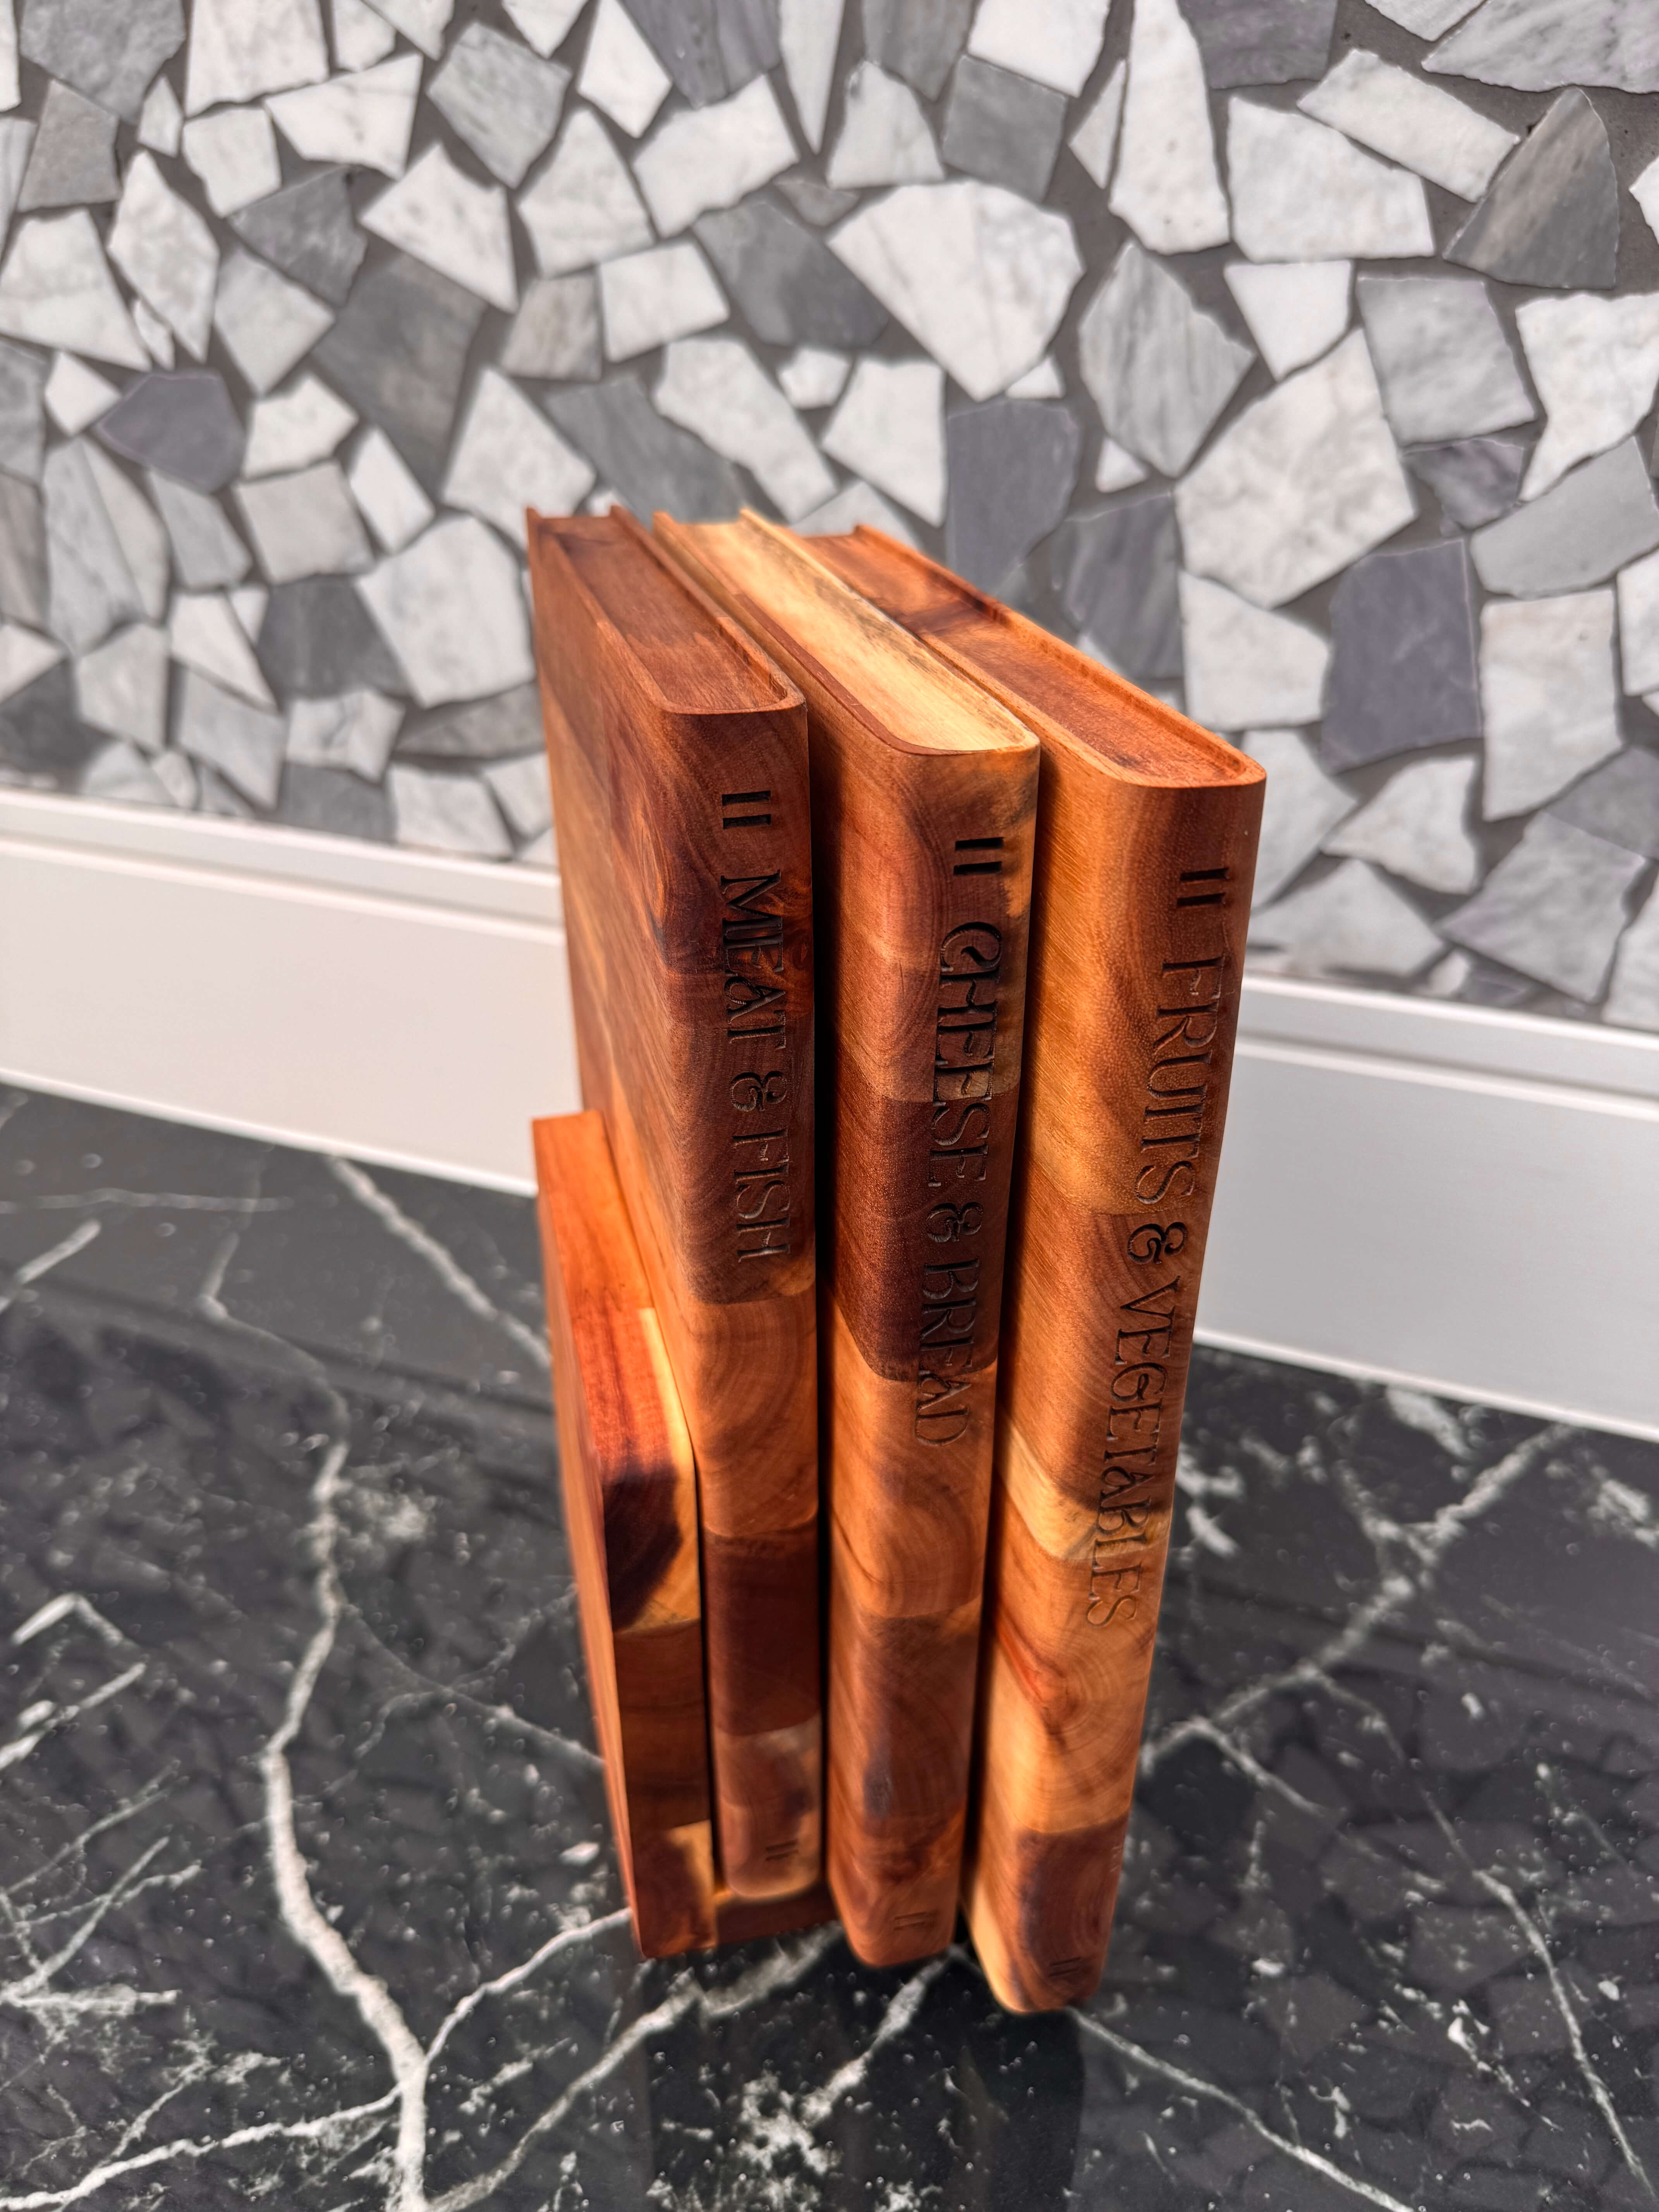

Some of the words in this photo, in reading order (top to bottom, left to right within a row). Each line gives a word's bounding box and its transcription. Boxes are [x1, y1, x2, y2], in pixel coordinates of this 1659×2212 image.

[721, 871, 786, 1049] MEAT
[730, 1070, 787, 1112] &
[928, 921, 1003, 1188] CHEESE
[1135, 954, 1225, 1204] FRUITS
[733, 1128, 791, 1262] FISH
[926, 1202, 984, 1243] &
[1127, 1222, 1188, 1264] &
[915, 1258, 980, 1447] BREAD
[1086, 1276, 1182, 1628] VEGETABLES
